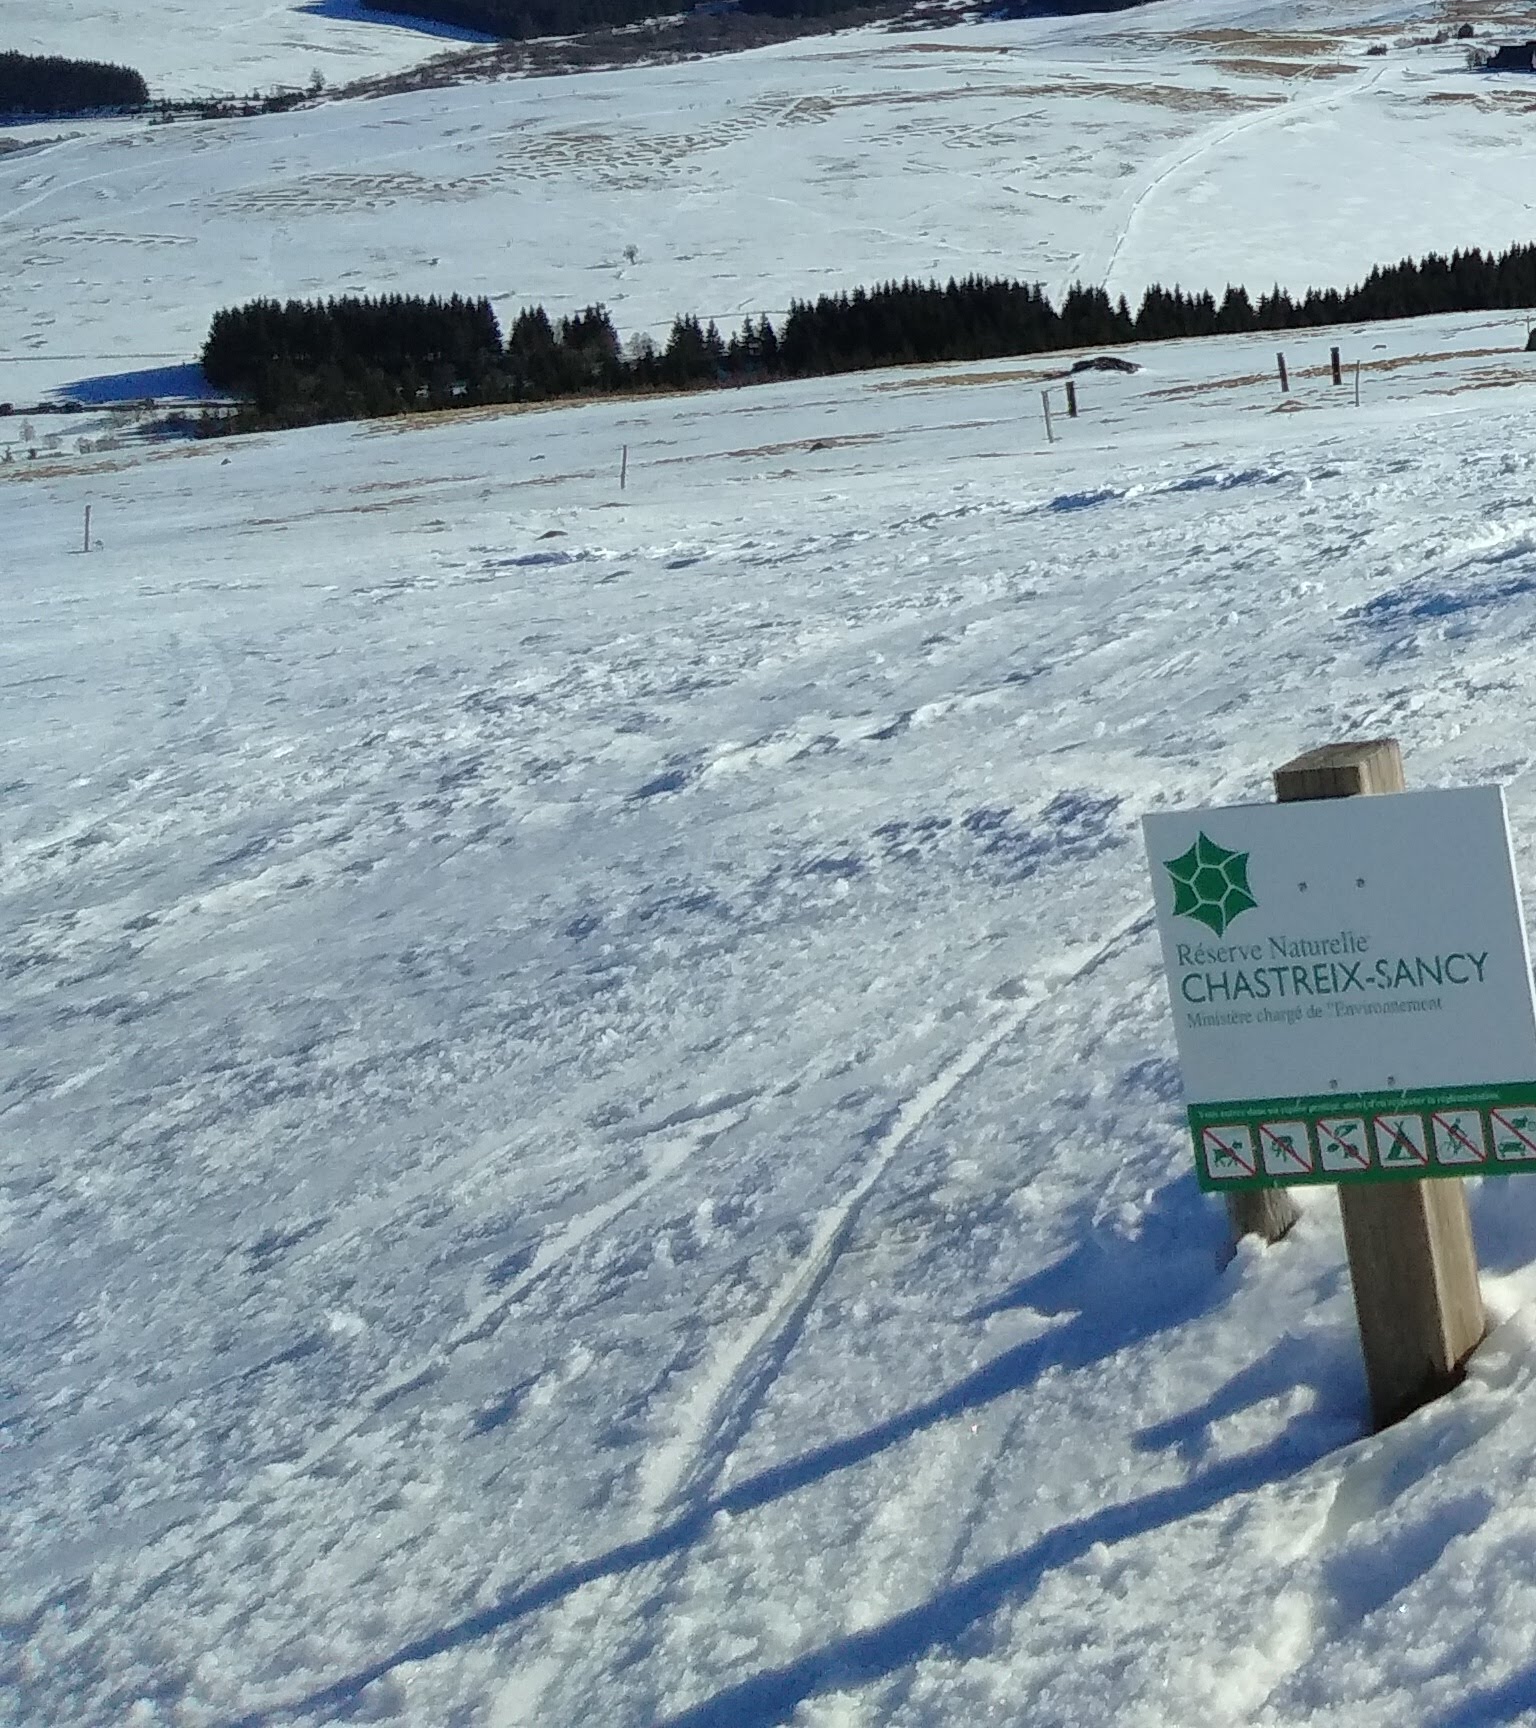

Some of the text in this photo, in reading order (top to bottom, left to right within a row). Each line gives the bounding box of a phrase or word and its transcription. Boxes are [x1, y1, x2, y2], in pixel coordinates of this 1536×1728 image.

[1176, 931, 1369, 966] Réserve Naturelle
[1181, 952, 1489, 1003] CHASTREIX-SANCY
[1307, 1004, 1322, 1018] de
